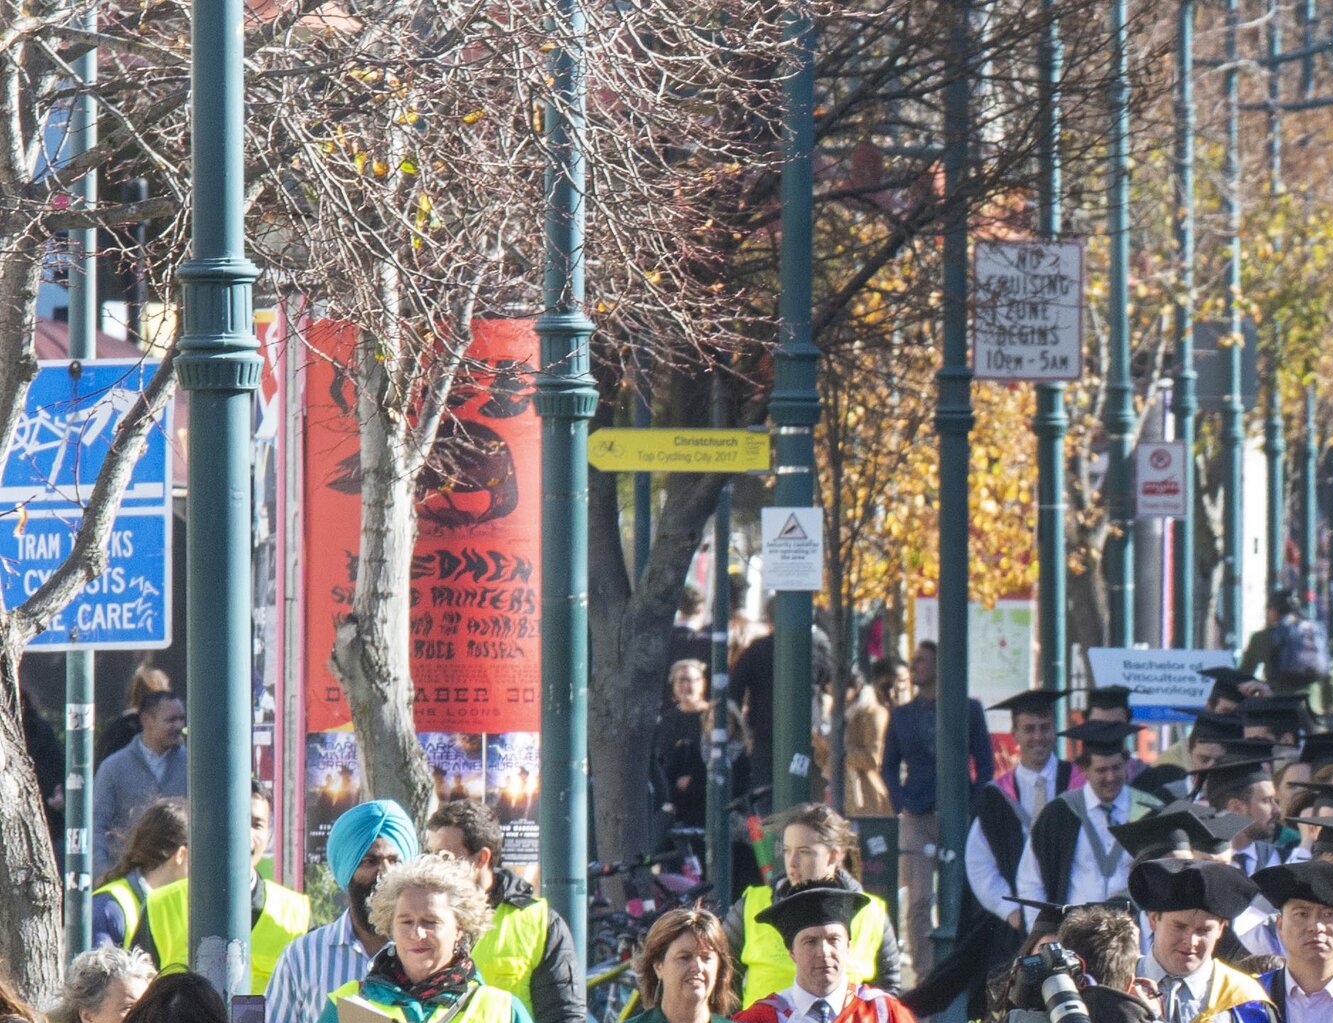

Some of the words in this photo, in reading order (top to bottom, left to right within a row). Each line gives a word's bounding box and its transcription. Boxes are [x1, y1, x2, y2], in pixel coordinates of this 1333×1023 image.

[674, 436, 738, 447] Christchurch
[638, 450, 655, 463] Top
[657, 450, 692, 464] Cycling
[715, 451, 738, 461] 2017
[17, 533, 60, 560] TRAM
[77, 603, 136, 630] CARE
[414, 639, 456, 659] RUCE
[1123, 660, 1185, 670] Bachelor
[426, 742, 457, 752] ARK
